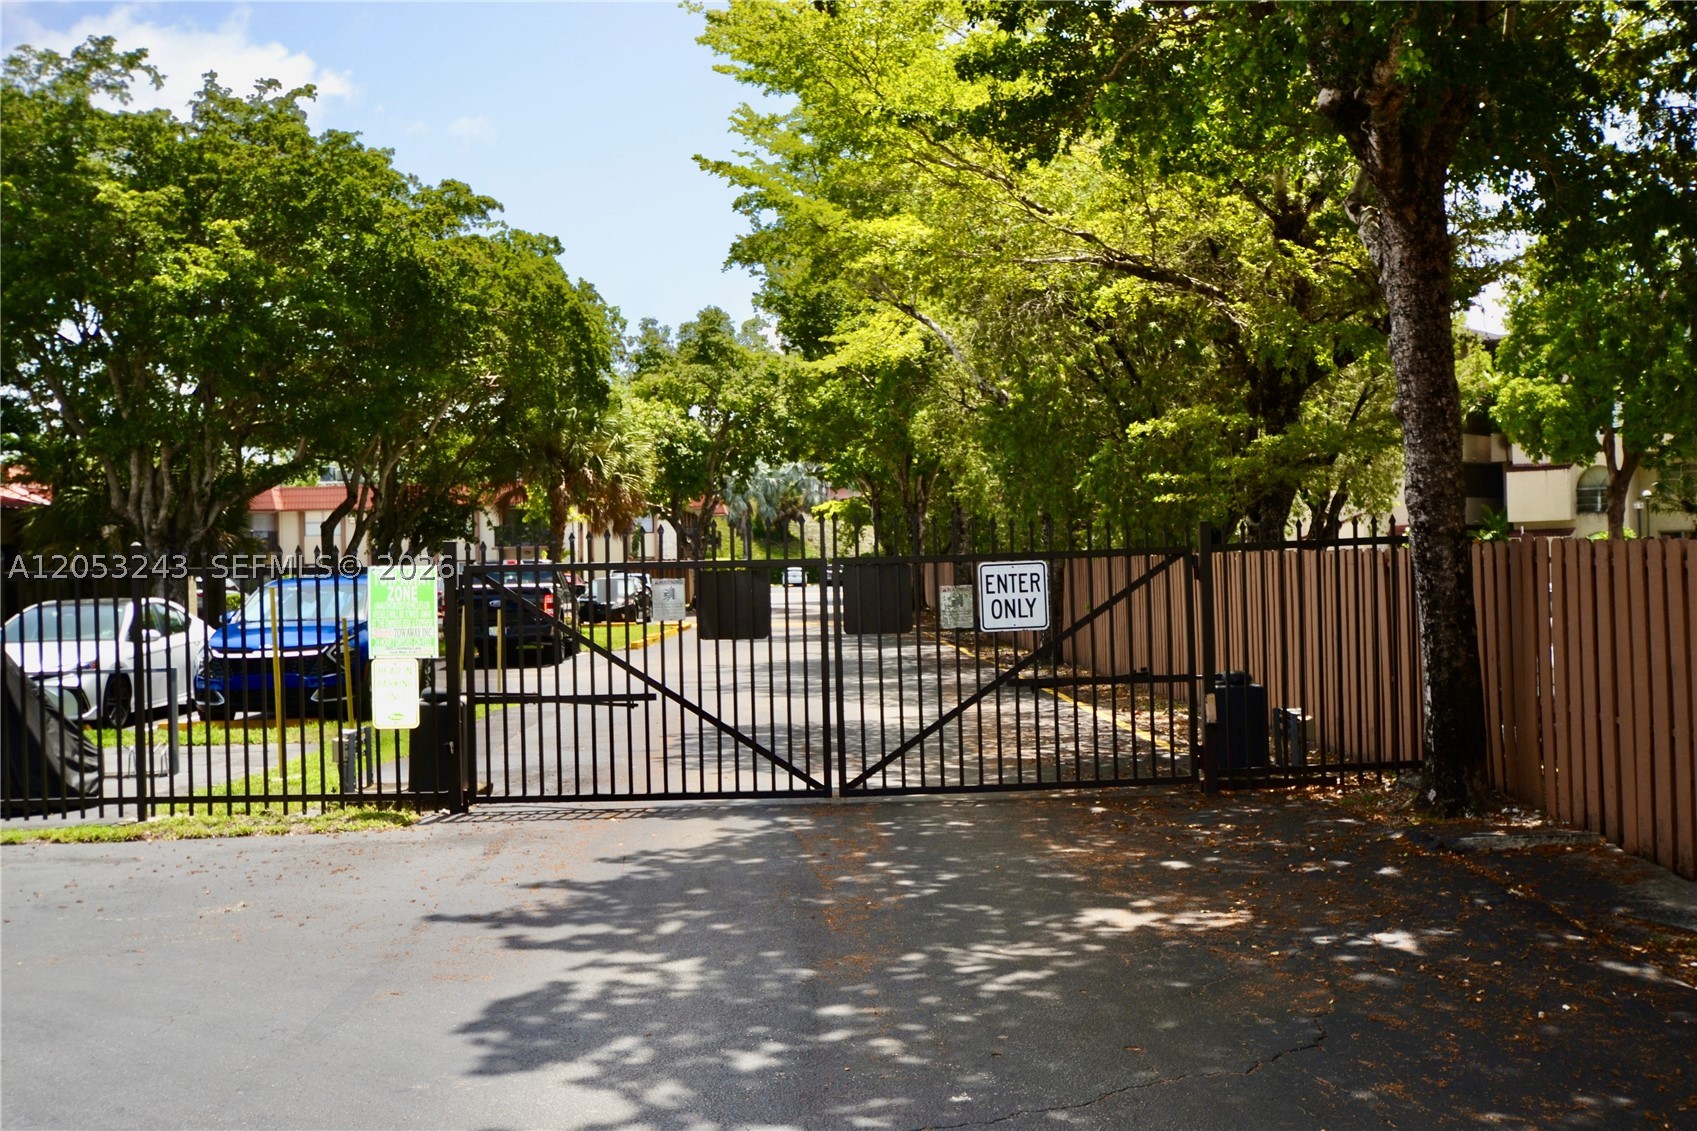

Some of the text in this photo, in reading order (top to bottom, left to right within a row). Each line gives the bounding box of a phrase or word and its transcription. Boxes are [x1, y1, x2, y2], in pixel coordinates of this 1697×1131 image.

[387, 585, 419, 602] ZONE
[985, 572, 1041, 595] ENTER
[991, 597, 1037, 620] ONLY
[393, 628, 407, 638] TOW
[407, 628, 422, 638] AWAY
